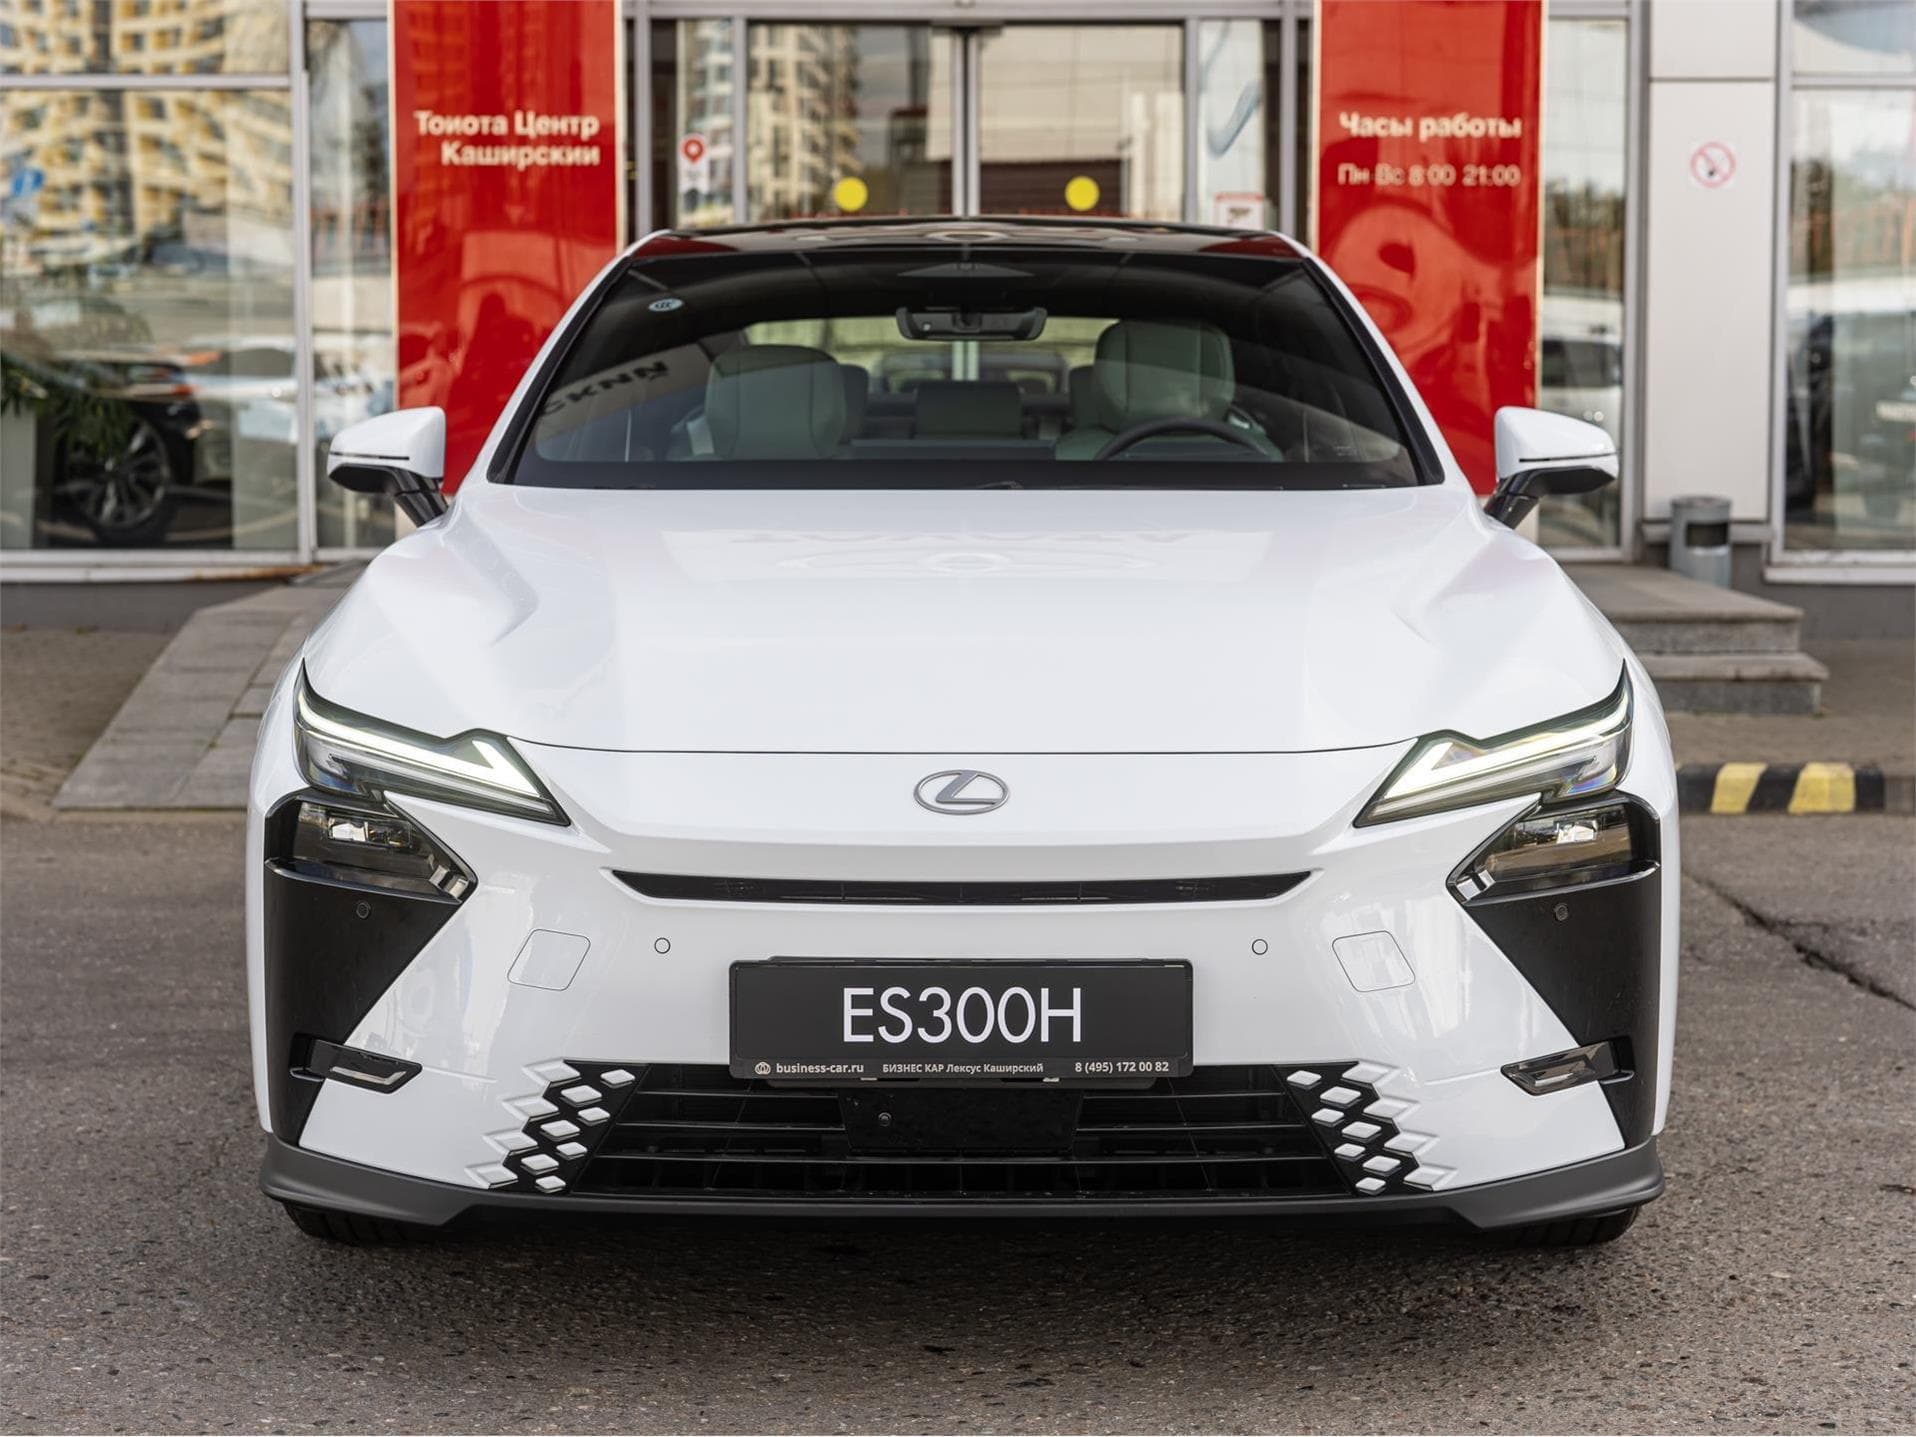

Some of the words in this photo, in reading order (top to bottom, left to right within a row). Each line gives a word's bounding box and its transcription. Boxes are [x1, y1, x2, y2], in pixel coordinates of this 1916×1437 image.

[514, 110, 600, 141] Центр
[1339, 111, 1413, 137] Часы
[1419, 112, 1522, 143] работы
[842, 986, 1082, 1043] ES300H
[776, 1062, 864, 1073] business-car.ru
[882, 1064, 922, 1073] БИЗНЕС
[924, 1064, 944, 1073] КАР
[946, 1064, 981, 1075] Лексус
[983, 1063, 1044, 1075] Каширский
[1074, 1062, 1081, 1072] 8
[1084, 1062, 1113, 1074] (495)
[1116, 1062, 1136, 1072] 172
[1138, 1062, 1152, 1072] 00
[1155, 1062, 1169, 1072] 82
